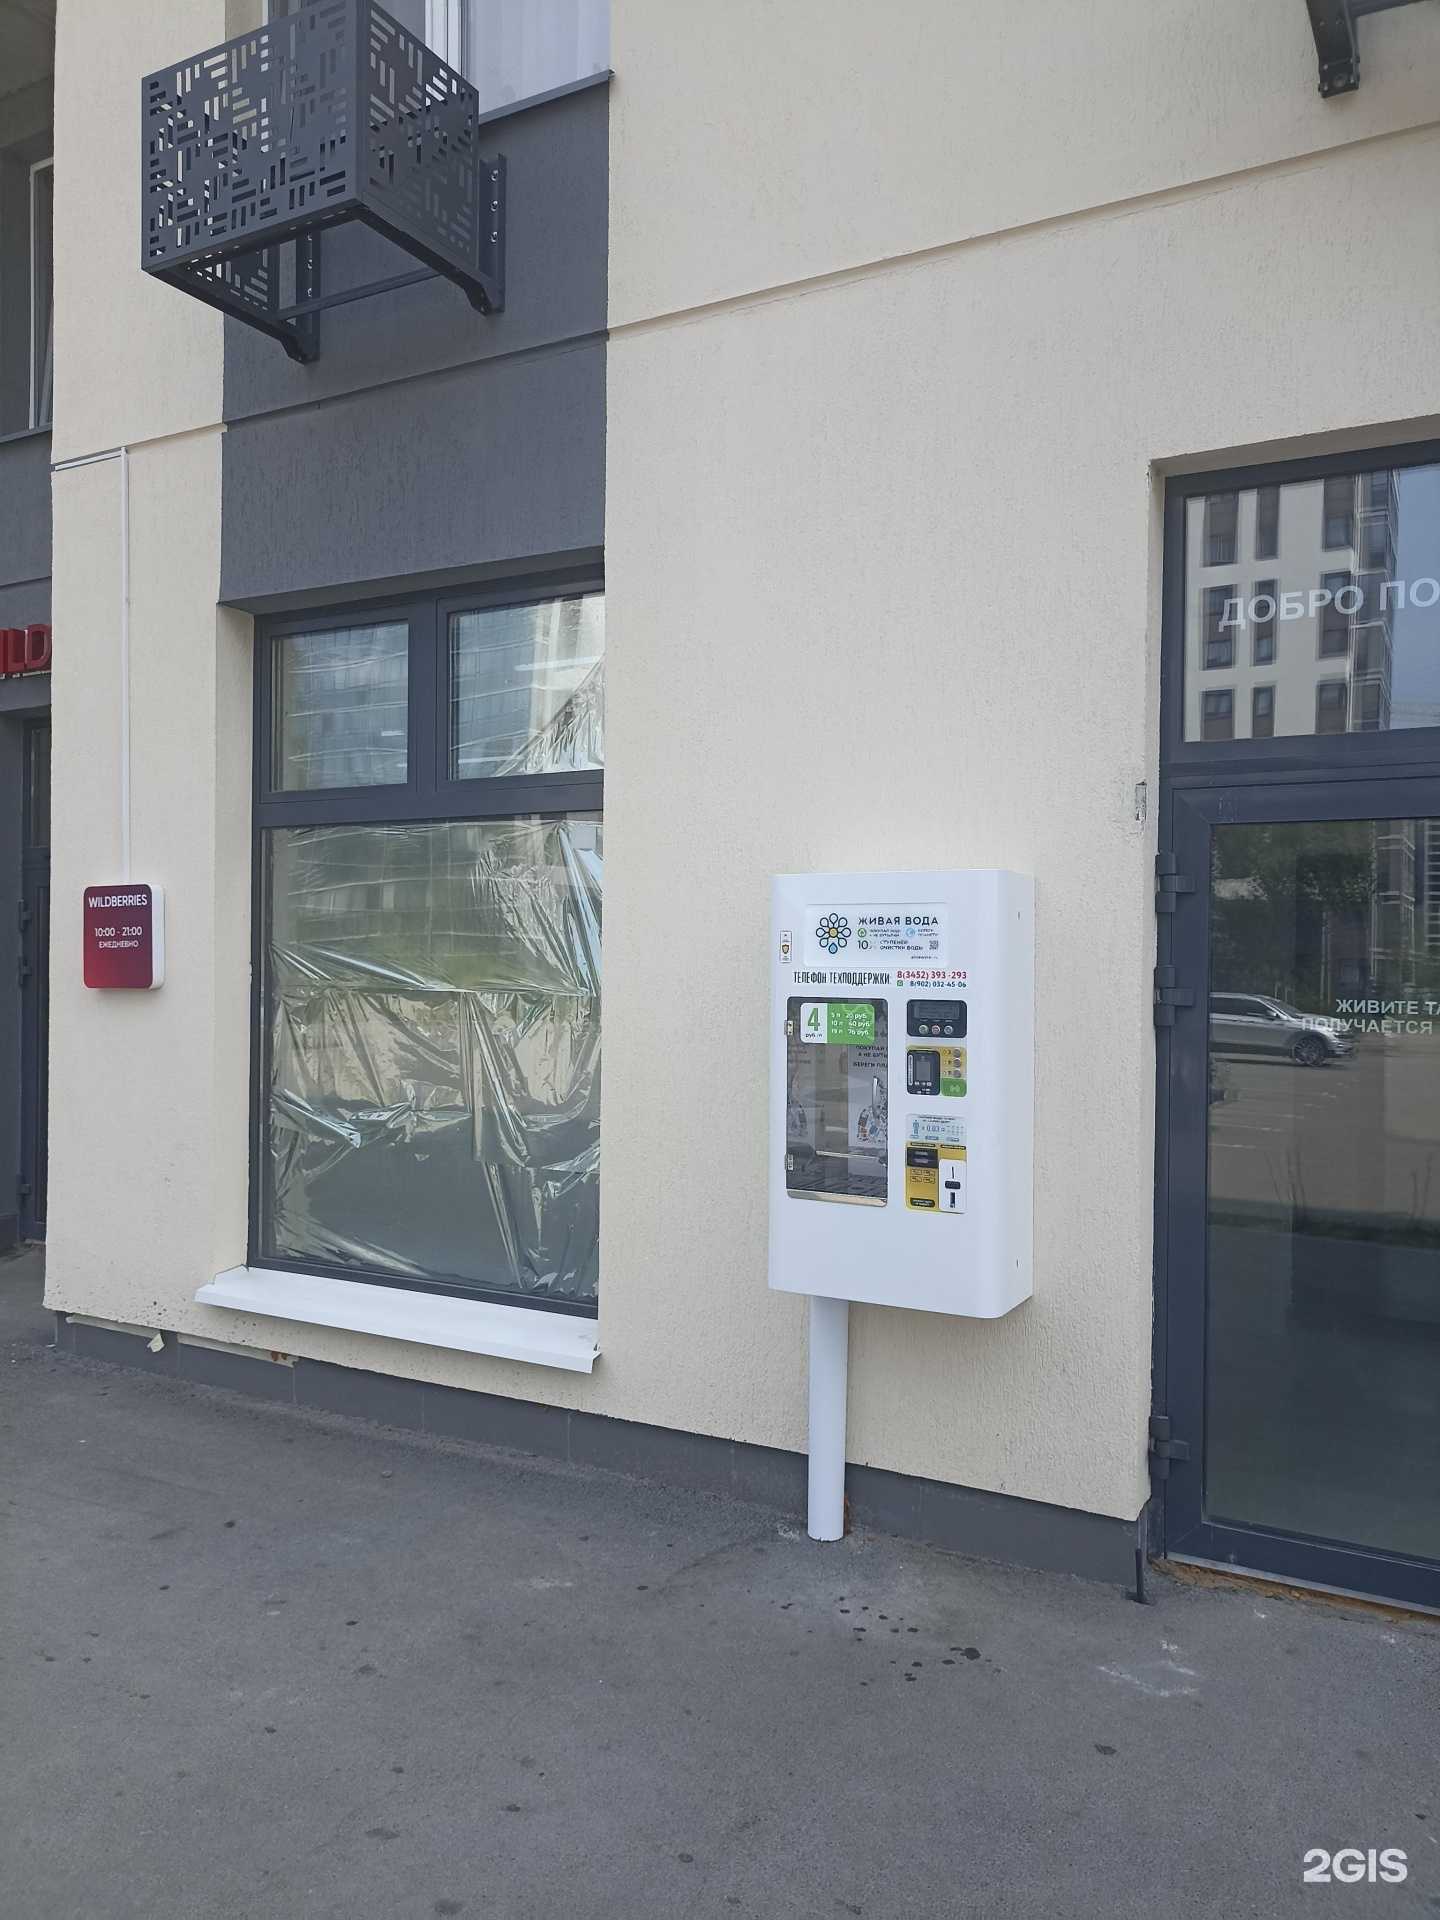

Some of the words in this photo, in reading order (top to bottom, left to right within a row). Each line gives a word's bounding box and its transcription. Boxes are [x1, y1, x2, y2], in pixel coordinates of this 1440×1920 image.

[1218, 585, 1364, 632] ДОБРО
[1379, 577, 1440, 611] ПО
[88, 894, 148, 908] WILDBERRIES
[858, 916, 900, 926] ЖИВАЯ
[905, 916, 939, 926] ВОДА
[95, 927, 115, 937] 10:00
[122, 926, 143, 936] 21:00
[98, 940, 139, 949] ЕЖЕДНЕВНО
[794, 971, 827, 984] ТЕЛЕФОН
[896, 970, 929, 980] 8(3452)
[931, 970, 946, 979] 393
[1335, 999, 1419, 1015] ЖИВИТЕ
[807, 1007, 821, 1031] 4
[1302, 1017, 1433, 1035] ПОЛУЧАЕТСЯ
